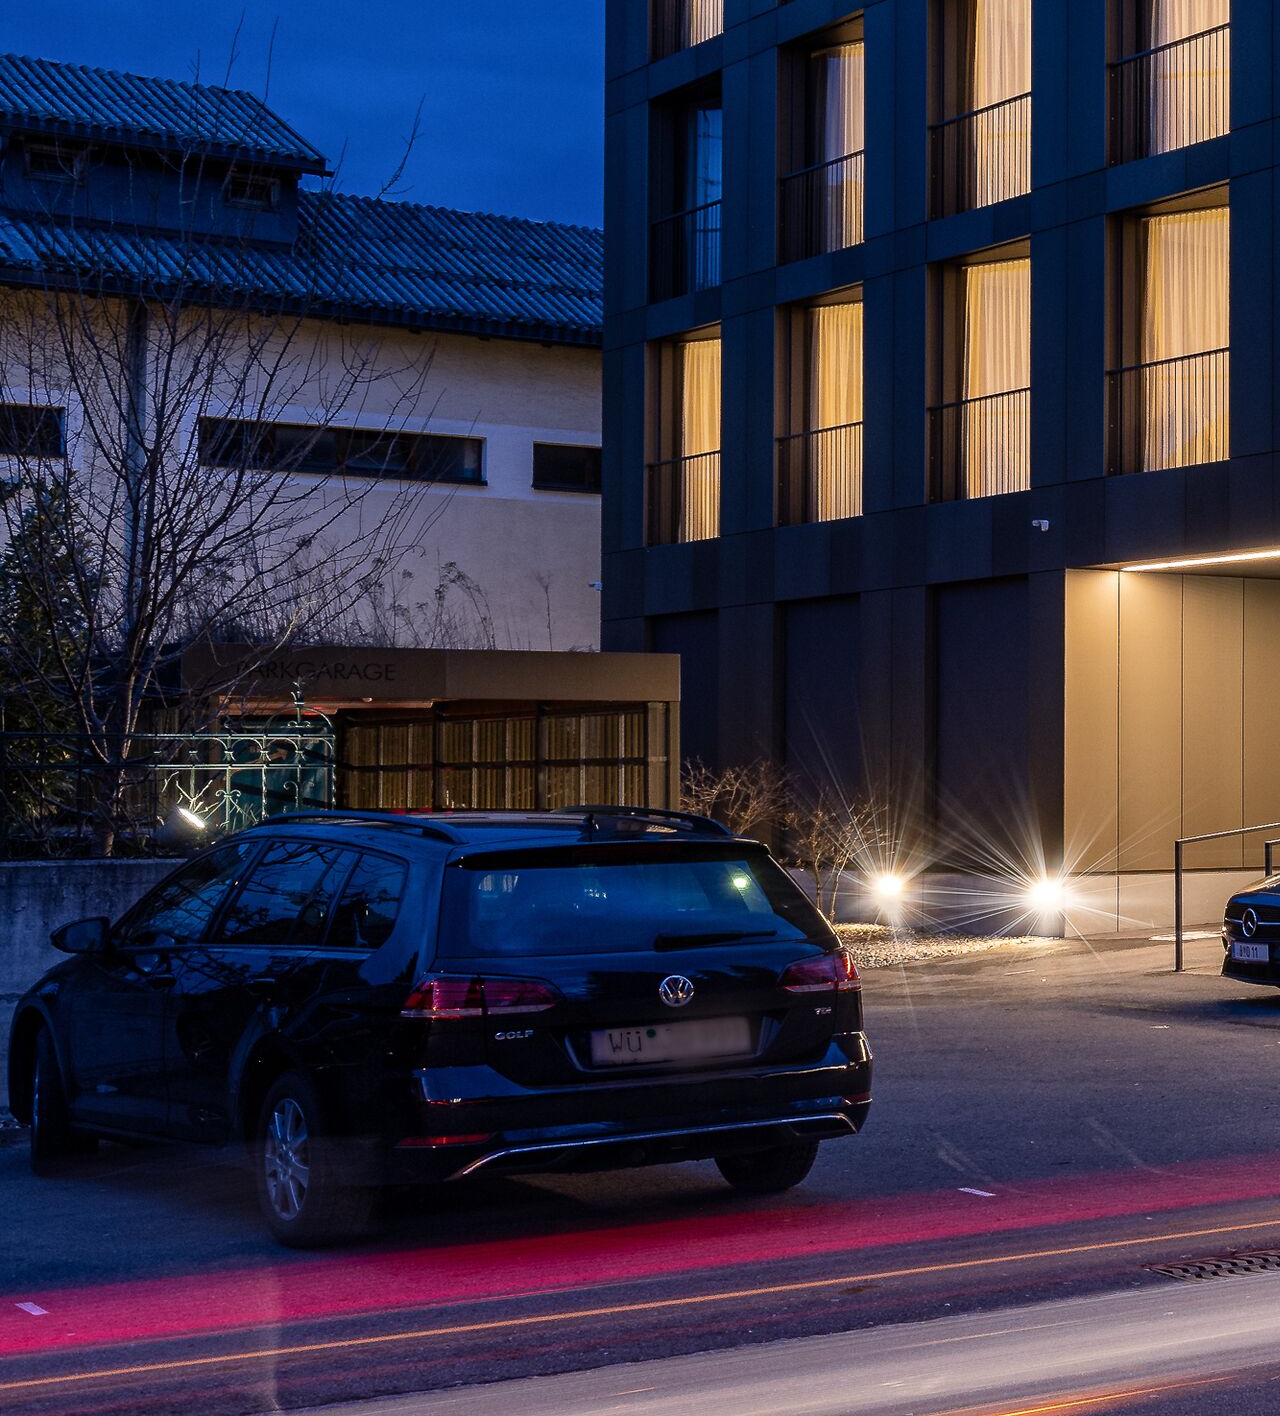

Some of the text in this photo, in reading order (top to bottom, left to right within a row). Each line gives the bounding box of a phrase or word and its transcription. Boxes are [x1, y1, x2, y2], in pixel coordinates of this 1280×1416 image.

[235, 660, 396, 681] PARKGARAGE
[494, 1029, 534, 1041] GOLF
[608, 1030, 642, 1054] WÜ
